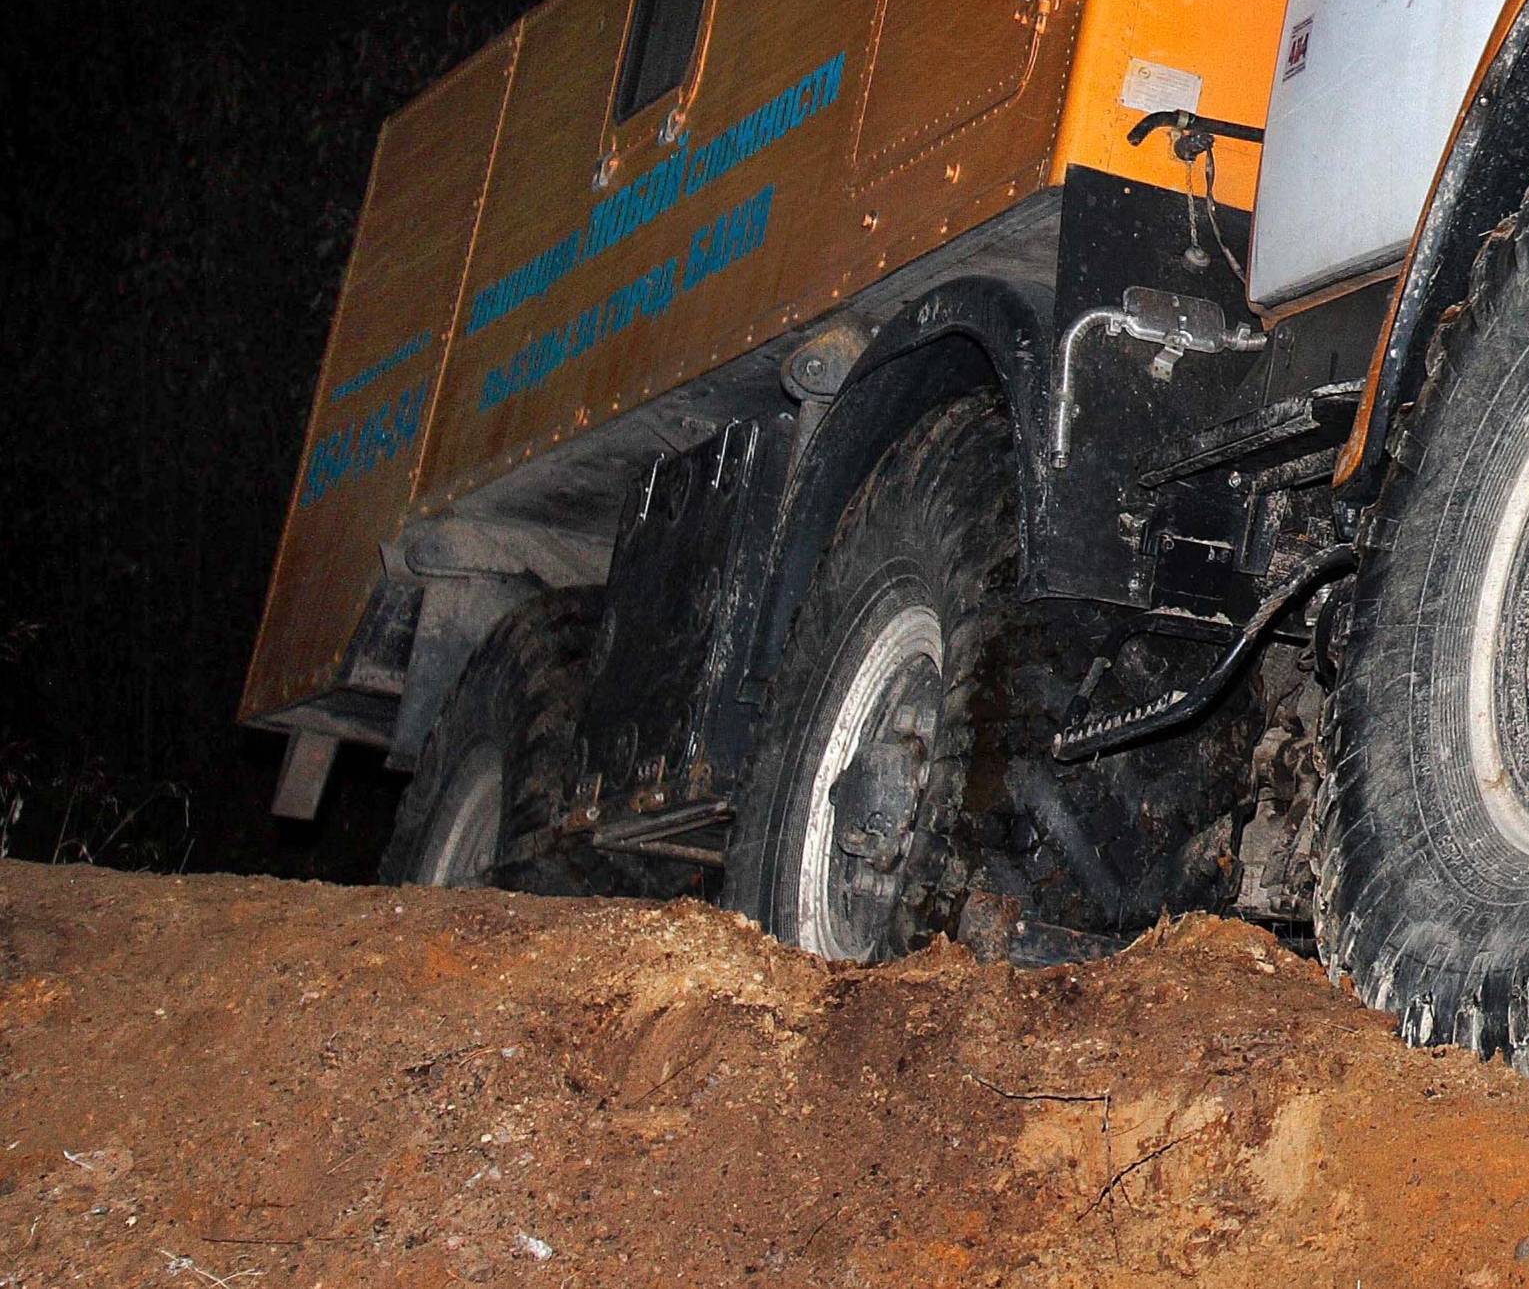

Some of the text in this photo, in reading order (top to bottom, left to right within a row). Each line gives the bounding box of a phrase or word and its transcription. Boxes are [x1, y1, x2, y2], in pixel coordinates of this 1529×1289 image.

[578, 130, 690, 264] ЛЮБОЙ
[685, 51, 845, 197] СЛОЖНОСТИ
[682, 183, 775, 293] БАНЯ
